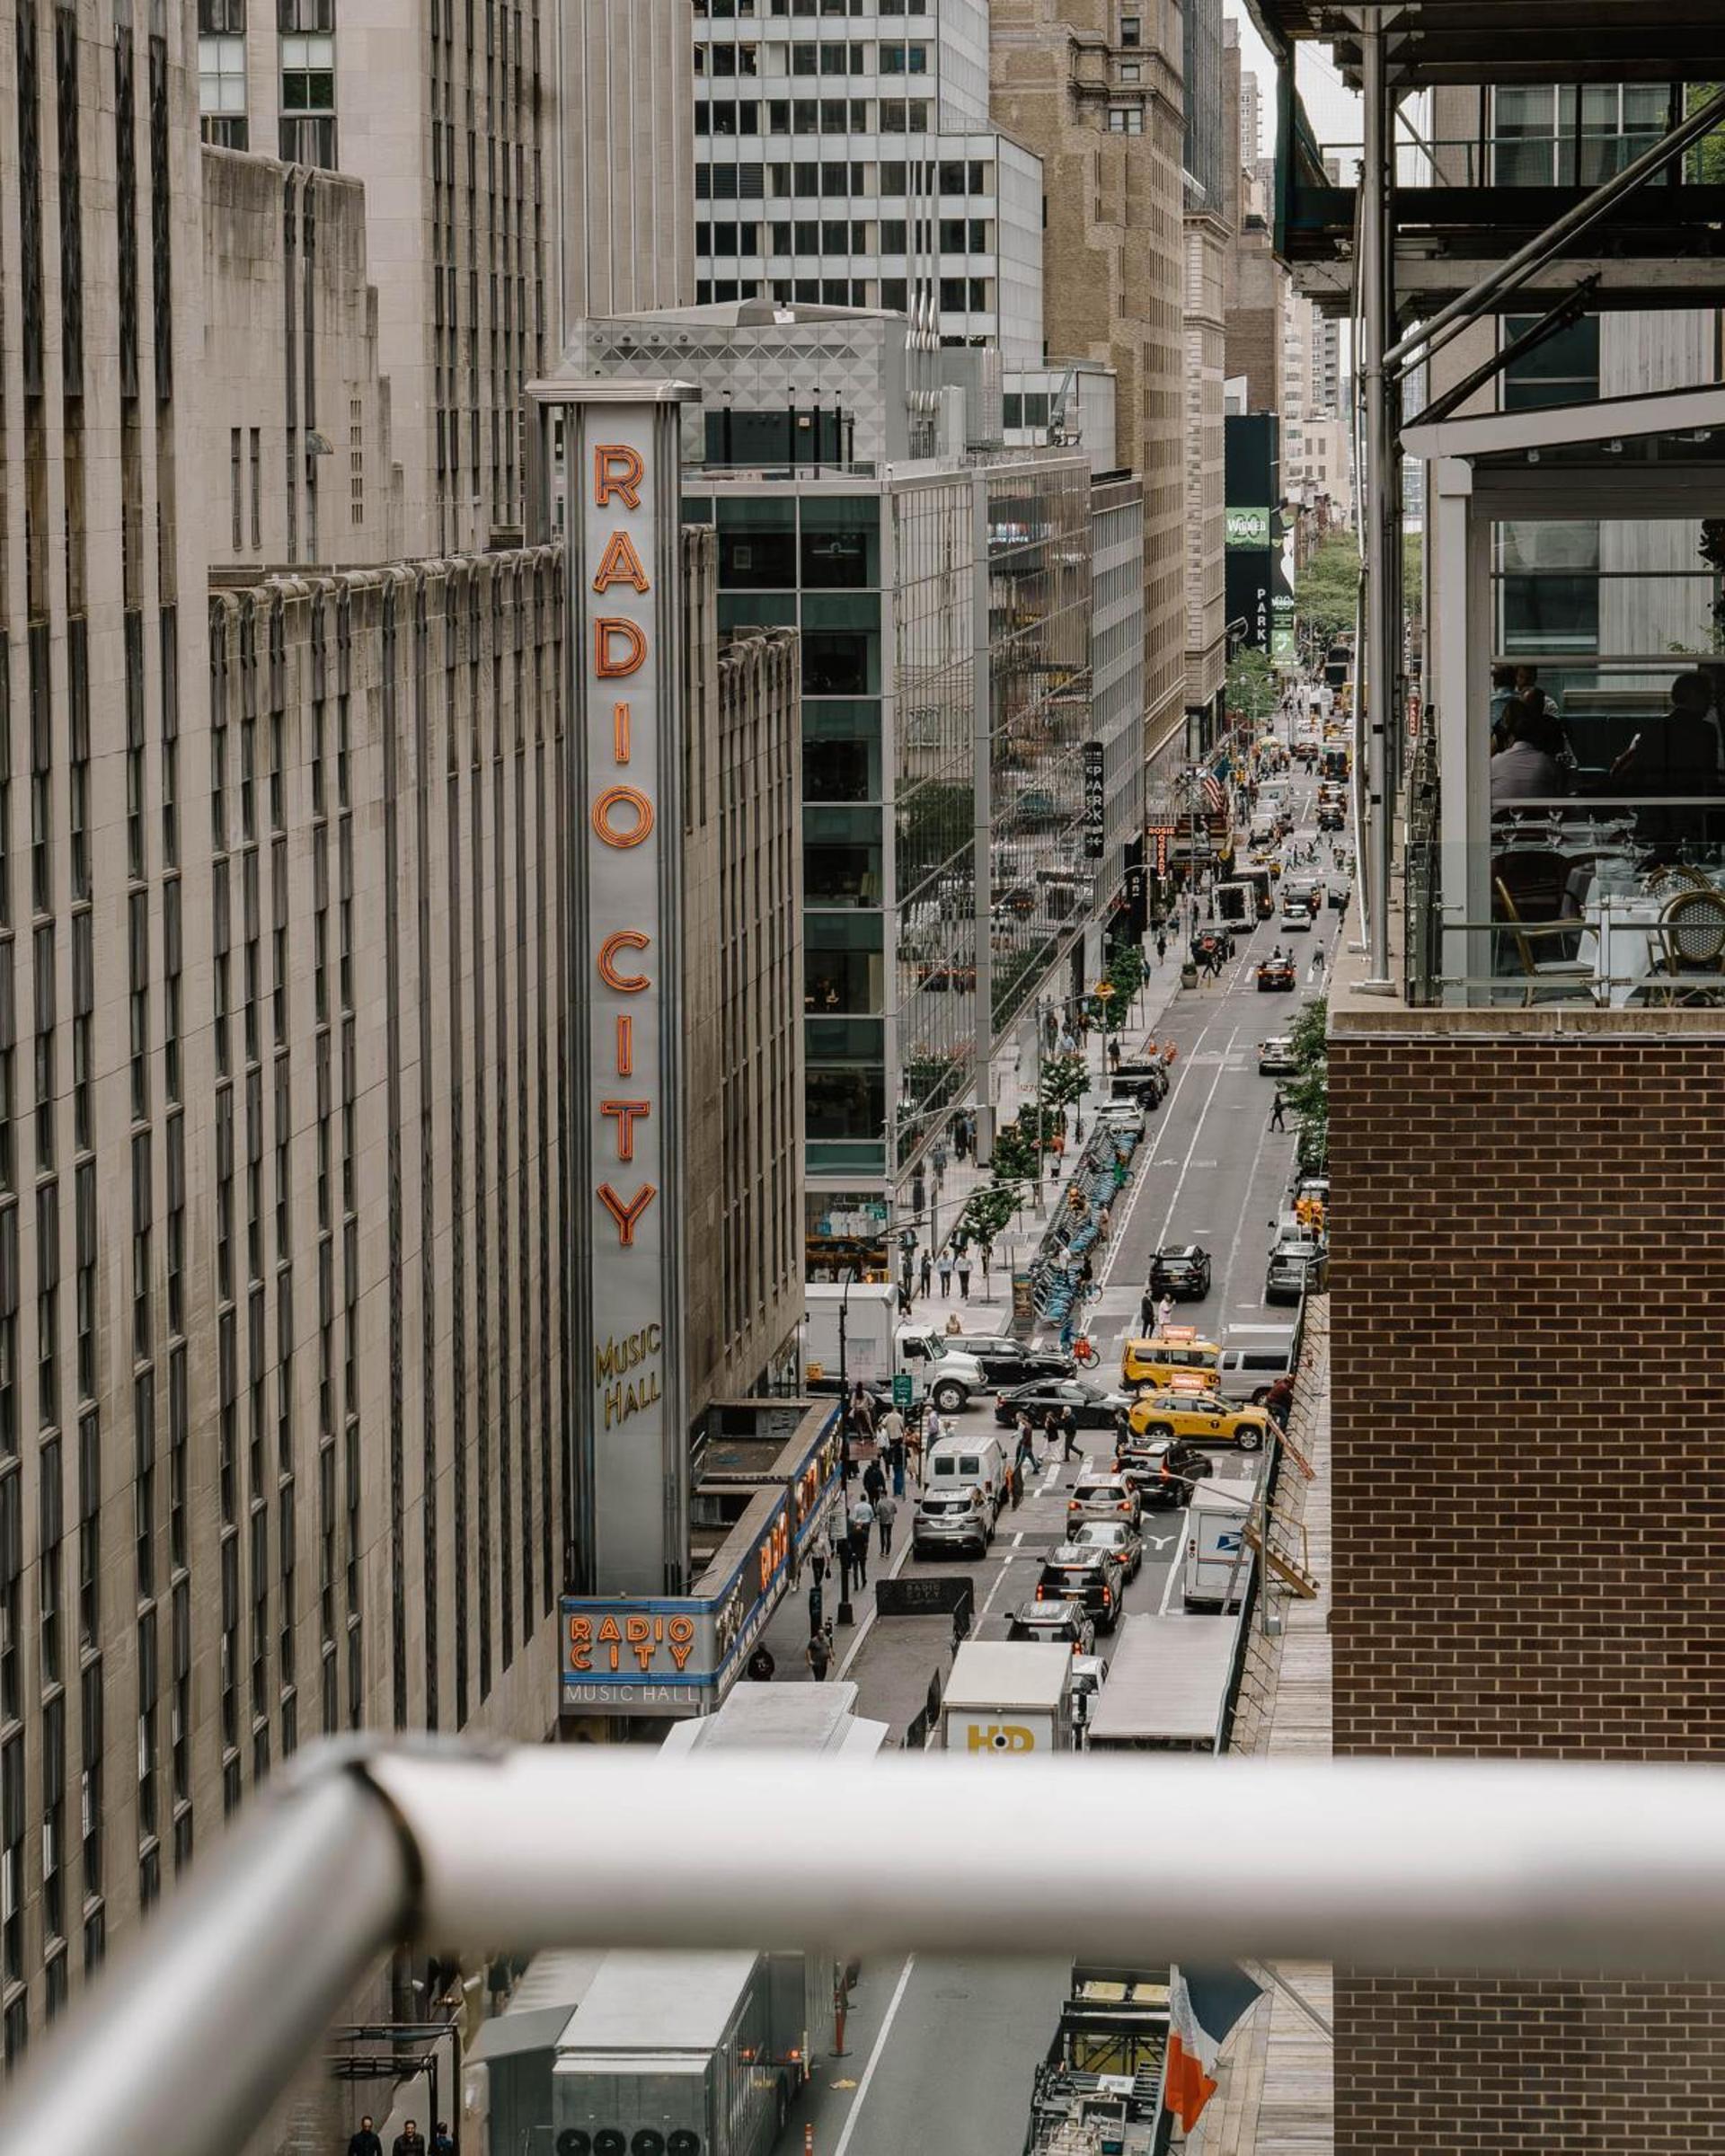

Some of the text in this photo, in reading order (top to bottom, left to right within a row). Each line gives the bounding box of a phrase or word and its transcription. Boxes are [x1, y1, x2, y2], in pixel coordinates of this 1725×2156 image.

[1257, 588, 1267, 641] PARK
[593, 445, 654, 849] RADIO
[1092, 765, 1103, 821] PARK
[597, 929, 657, 1246] CITY
[596, 1323, 661, 1389] MUSIC
[604, 1371, 661, 1431] HALL
[570, 1614, 694, 1643] RADIO
[570, 1643, 694, 1671] CITY
[566, 1685, 700, 1702] MUSIC HALL
